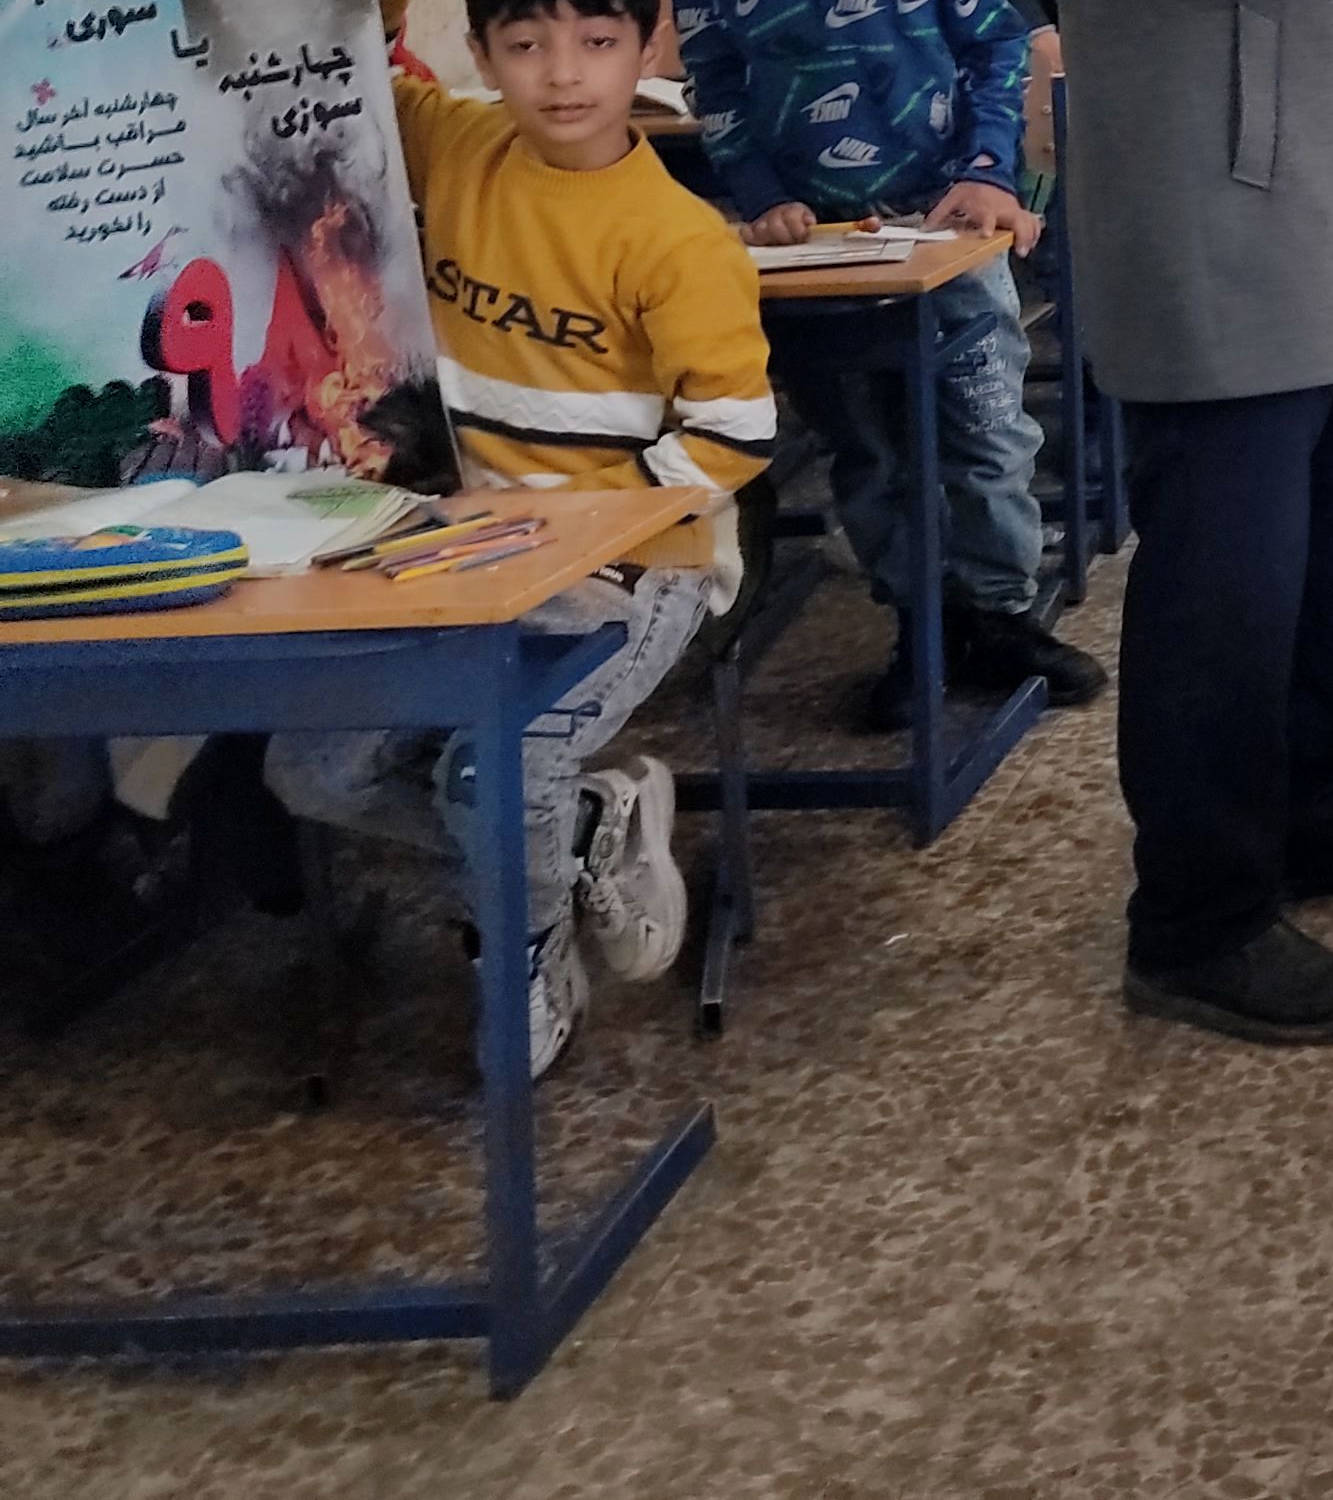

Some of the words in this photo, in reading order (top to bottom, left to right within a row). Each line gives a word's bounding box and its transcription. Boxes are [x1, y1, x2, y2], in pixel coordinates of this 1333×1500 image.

[66, 2, 157, 42] سوری
[171, 29, 210, 69] یا
[219, 44, 355, 101] چهارشنبه
[16, 108, 57, 133] سال
[272, 97, 363, 138] سوزی
[13, 132, 101, 161] باشید
[105, 119, 187, 148] مراقب
[20, 161, 91, 187] سلامت
[97, 152, 186, 180] حسرت
[95, 185, 148, 206] دست
[152, 176, 167, 205] از
[137, 210, 152, 237] را
[426, 258, 609, 355] STAR
